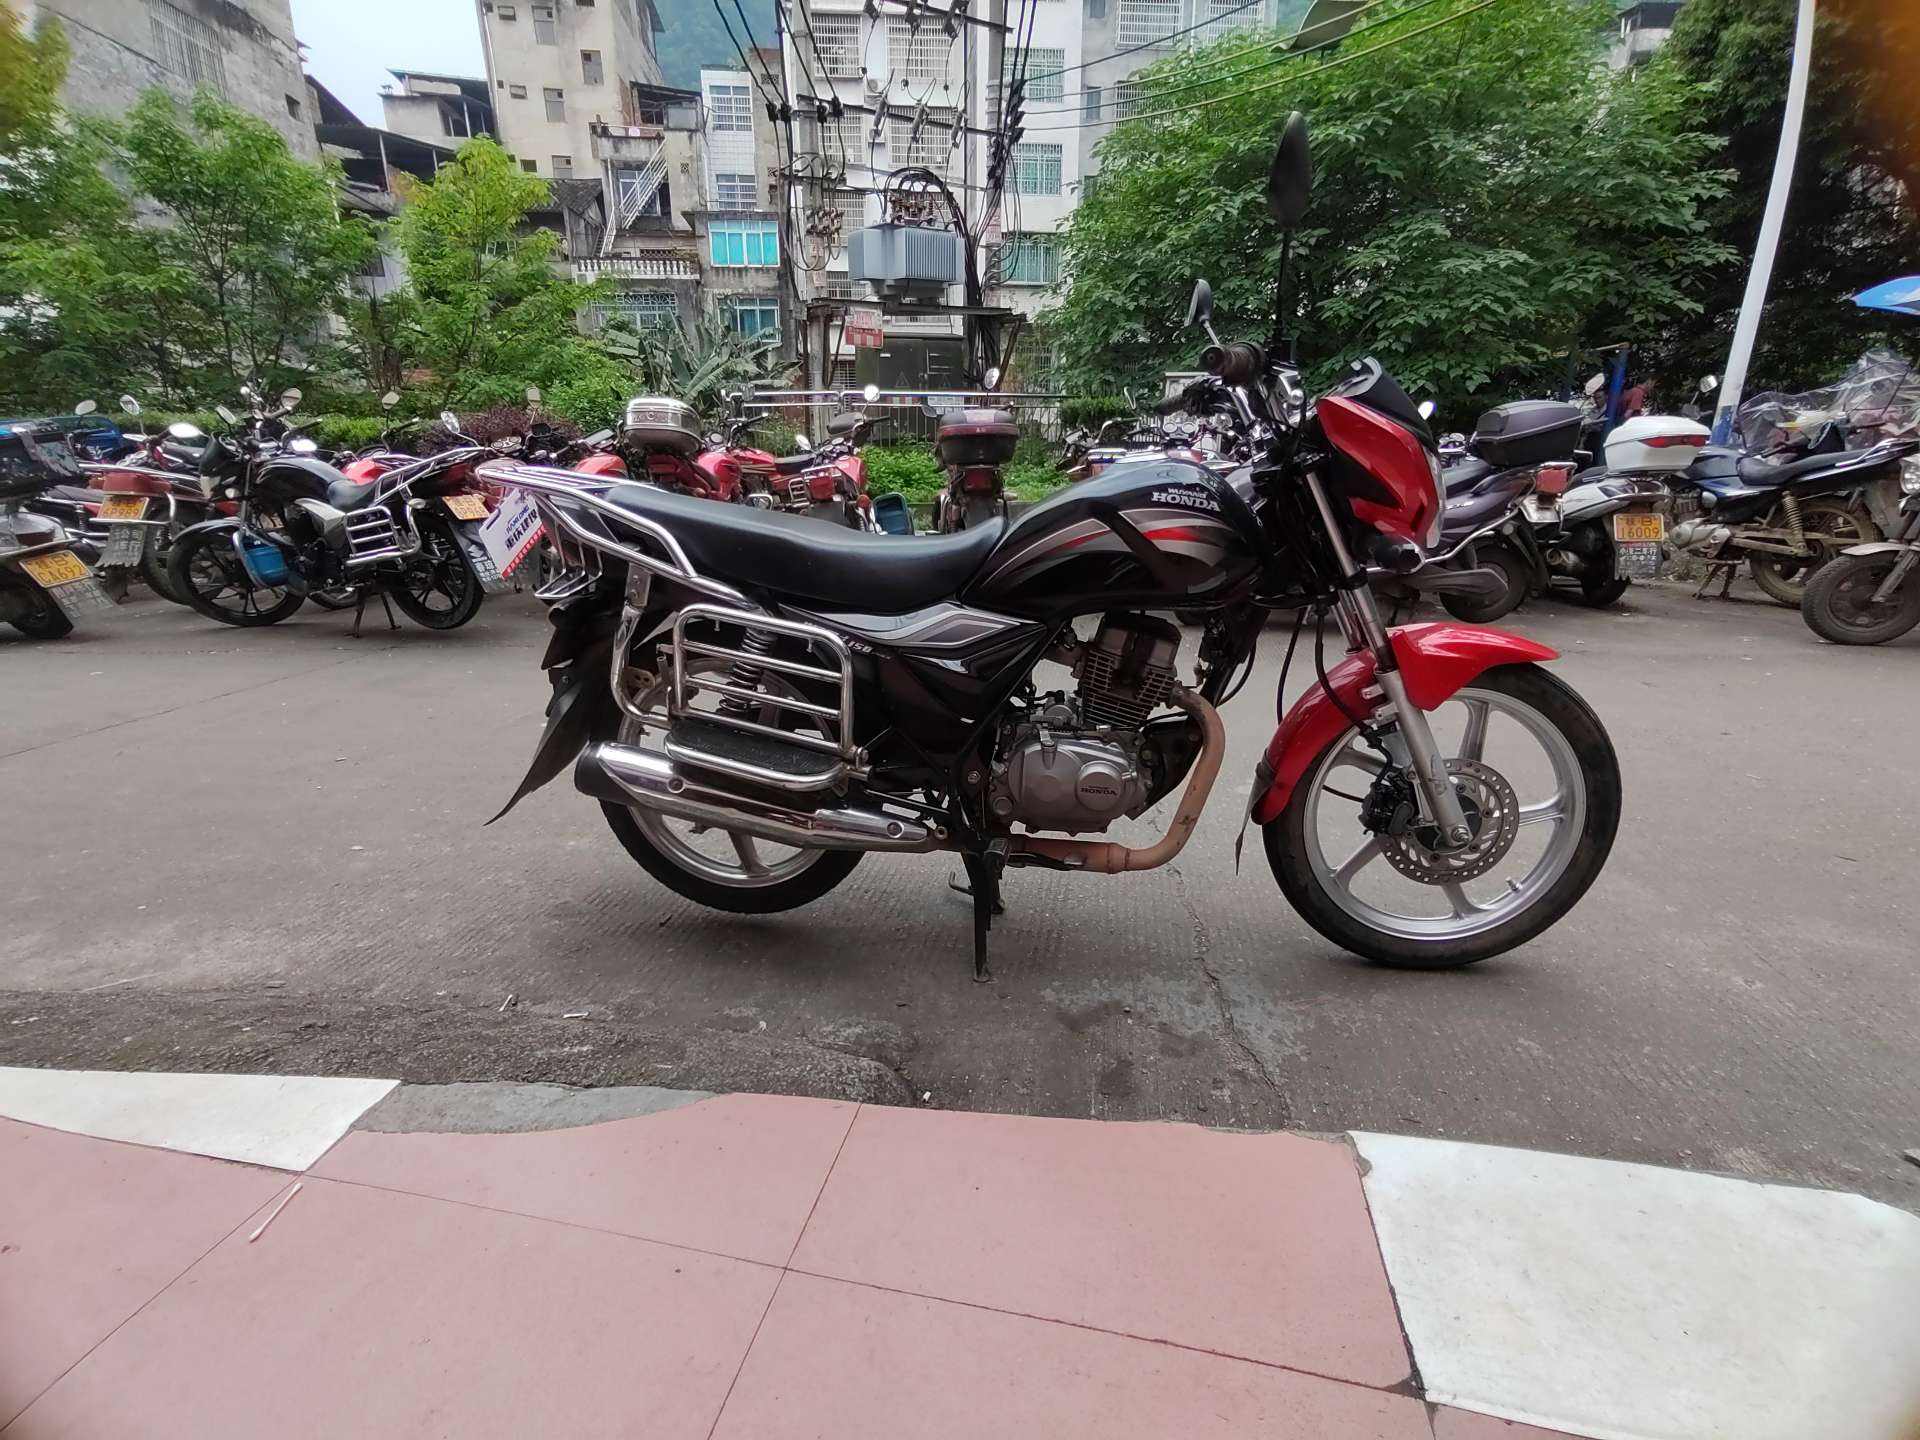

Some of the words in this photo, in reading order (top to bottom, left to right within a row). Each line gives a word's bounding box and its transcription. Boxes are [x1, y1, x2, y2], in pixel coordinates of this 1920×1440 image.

[1151, 491, 1221, 512] HONDA
[1621, 527, 1660, 538] 16009
[1080, 787, 1118, 796] HONDA
